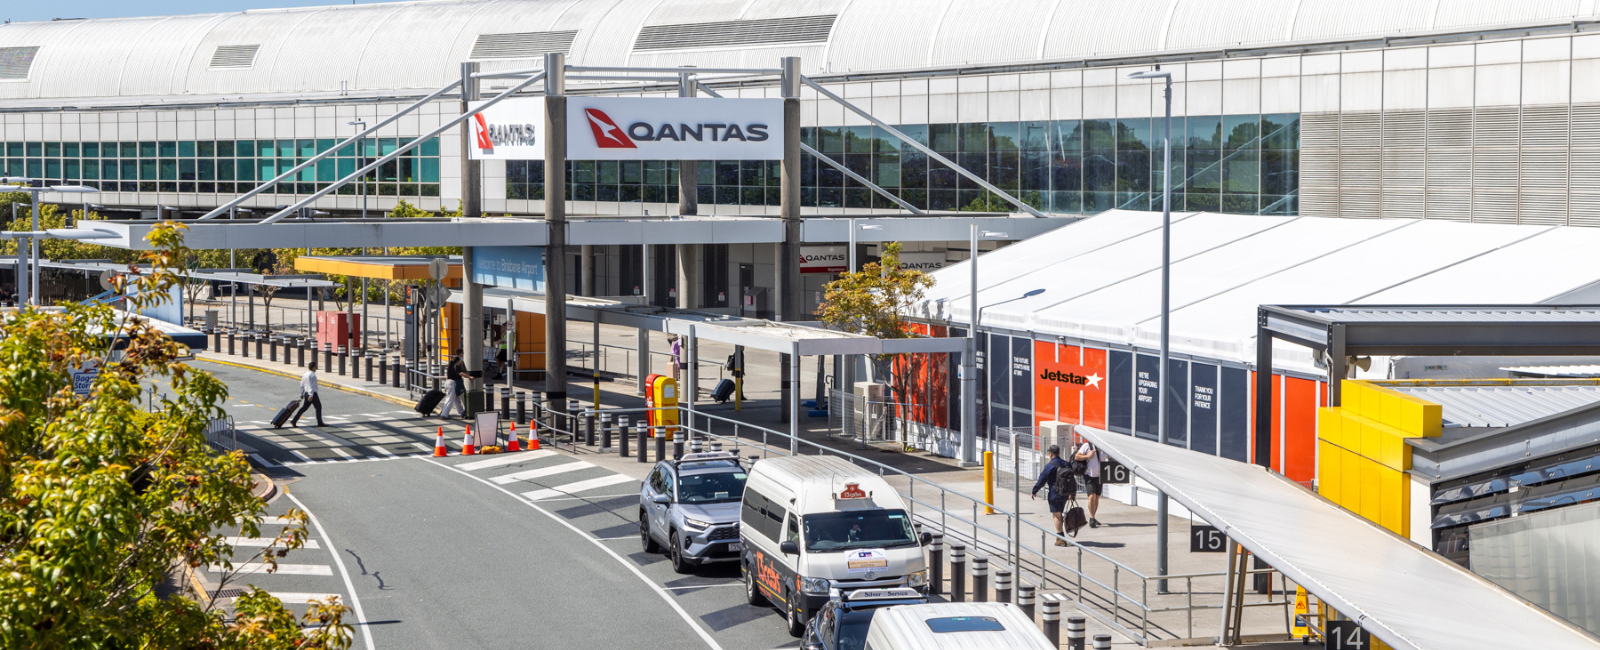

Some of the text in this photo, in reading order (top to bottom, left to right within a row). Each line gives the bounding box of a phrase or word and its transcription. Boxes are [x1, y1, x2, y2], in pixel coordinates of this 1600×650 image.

[488, 123, 535, 146] QANTAS
[628, 121, 769, 142] QANTAS
[476, 257, 496, 271] Welcome
[501, 259, 520, 273] Brisbane
[521, 261, 538, 277] Airport
[1040, 368, 1087, 385] Jetstar
[1138, 386, 1148, 394] YOUR
[1194, 385, 1207, 394] THANK
[1201, 394, 1212, 402] YOUR
[1138, 394, 1153, 403] AIRPORT
[1194, 400, 1211, 410] PATIENCE
[1103, 464, 1126, 482] 16
[1195, 529, 1222, 550] 15
[1331, 626, 1364, 650] 14
